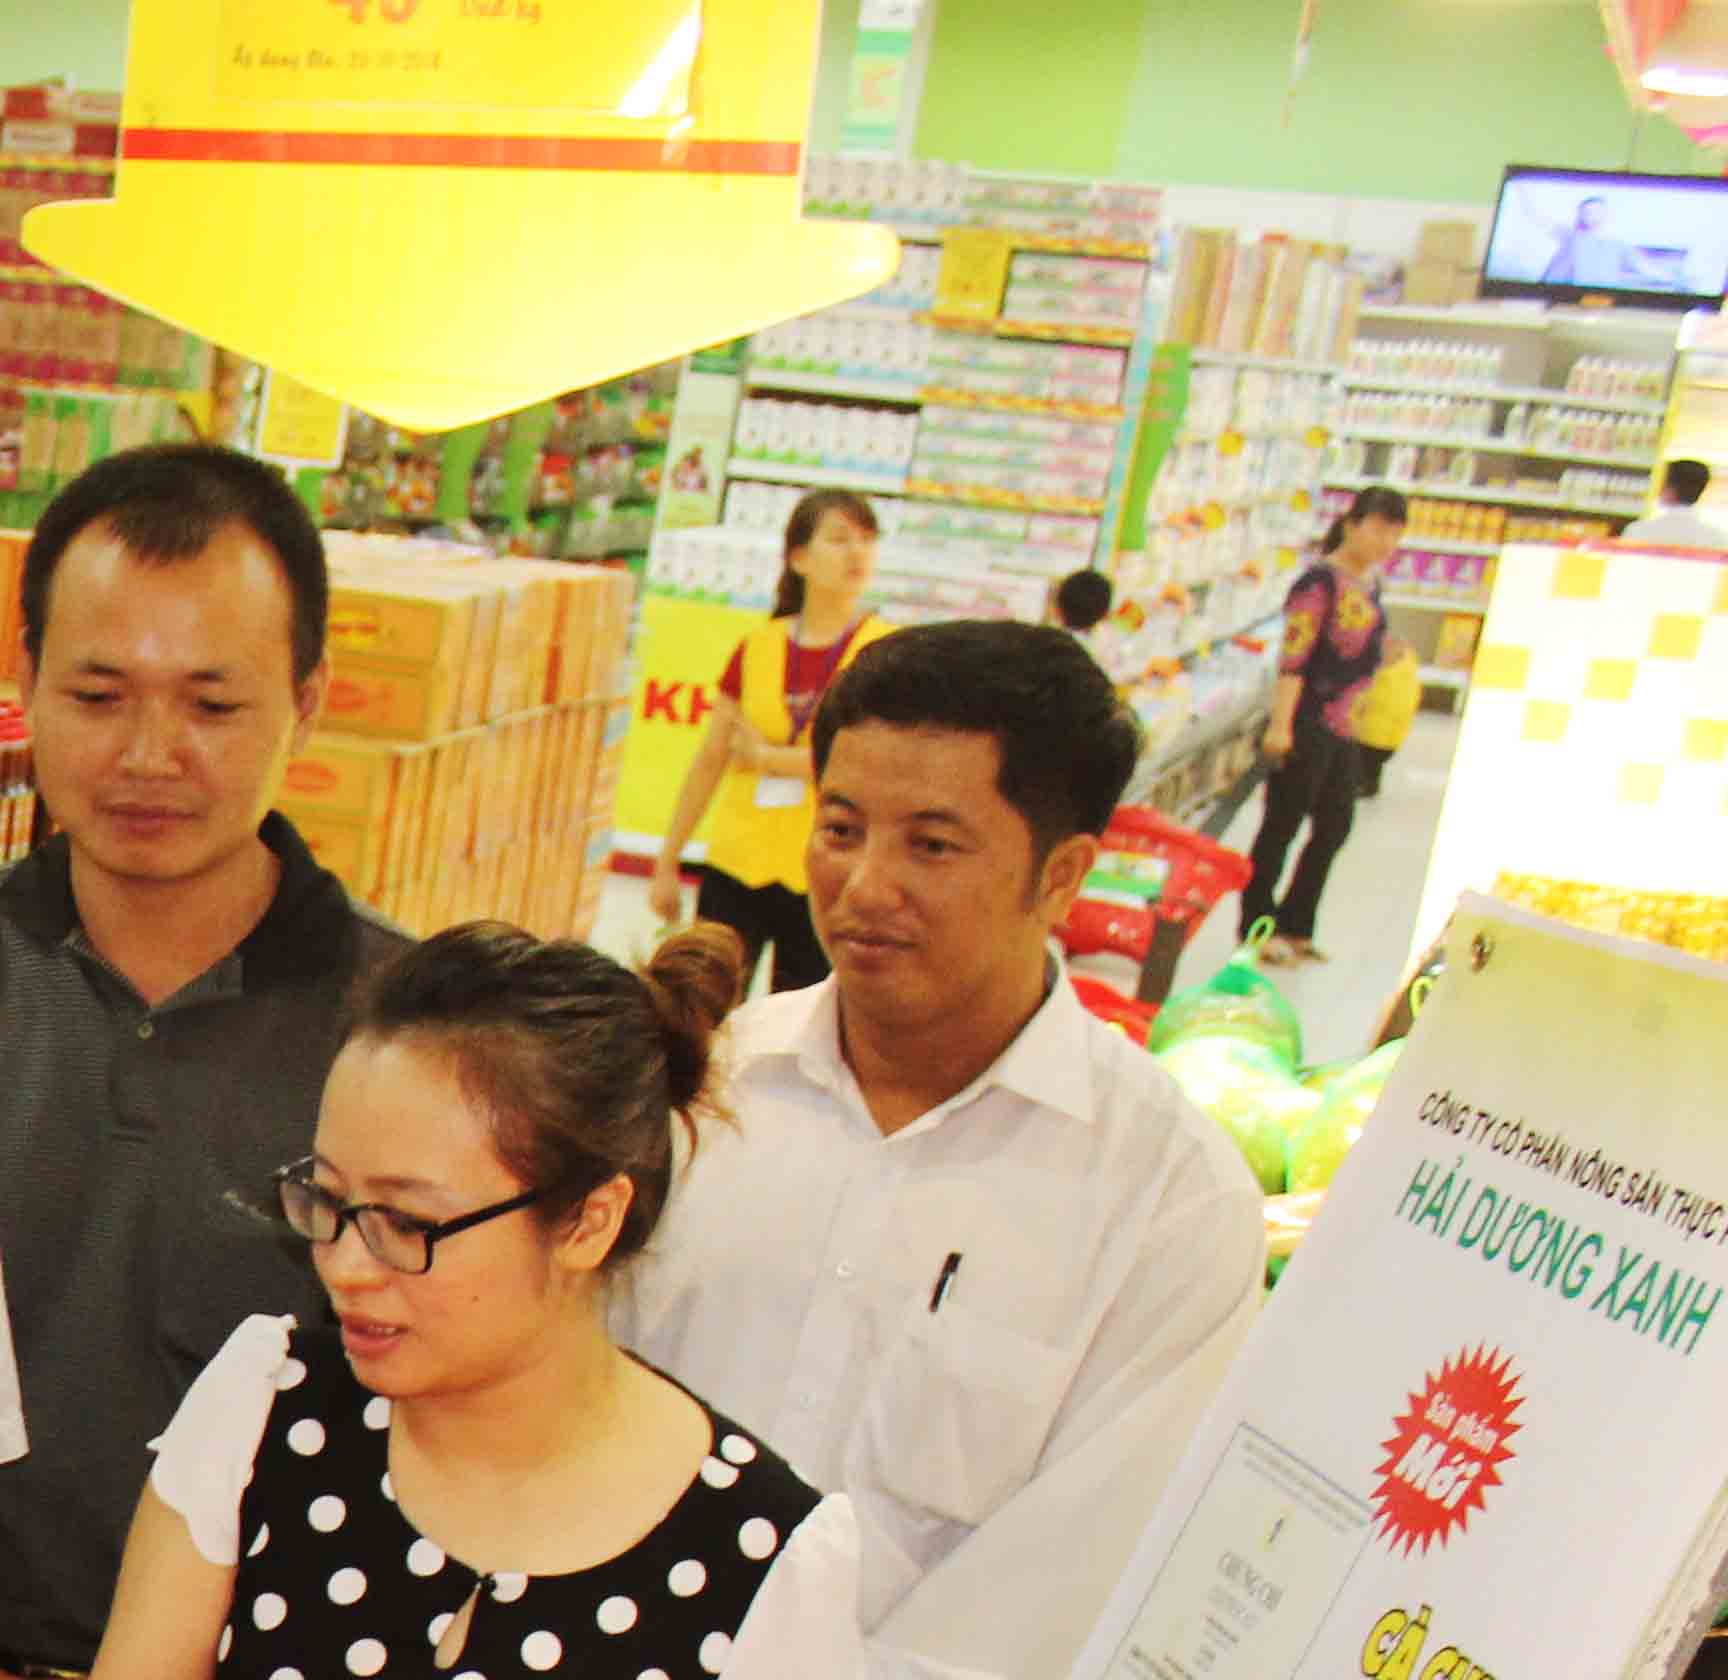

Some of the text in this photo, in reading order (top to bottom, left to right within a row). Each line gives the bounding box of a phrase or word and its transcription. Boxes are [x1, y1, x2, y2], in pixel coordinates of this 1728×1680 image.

[1468, 1110, 1498, 1145] TY
[1395, 1154, 1724, 1356] HẢI DƯƠNG XANH
[1393, 1433, 1482, 1510] Mới
